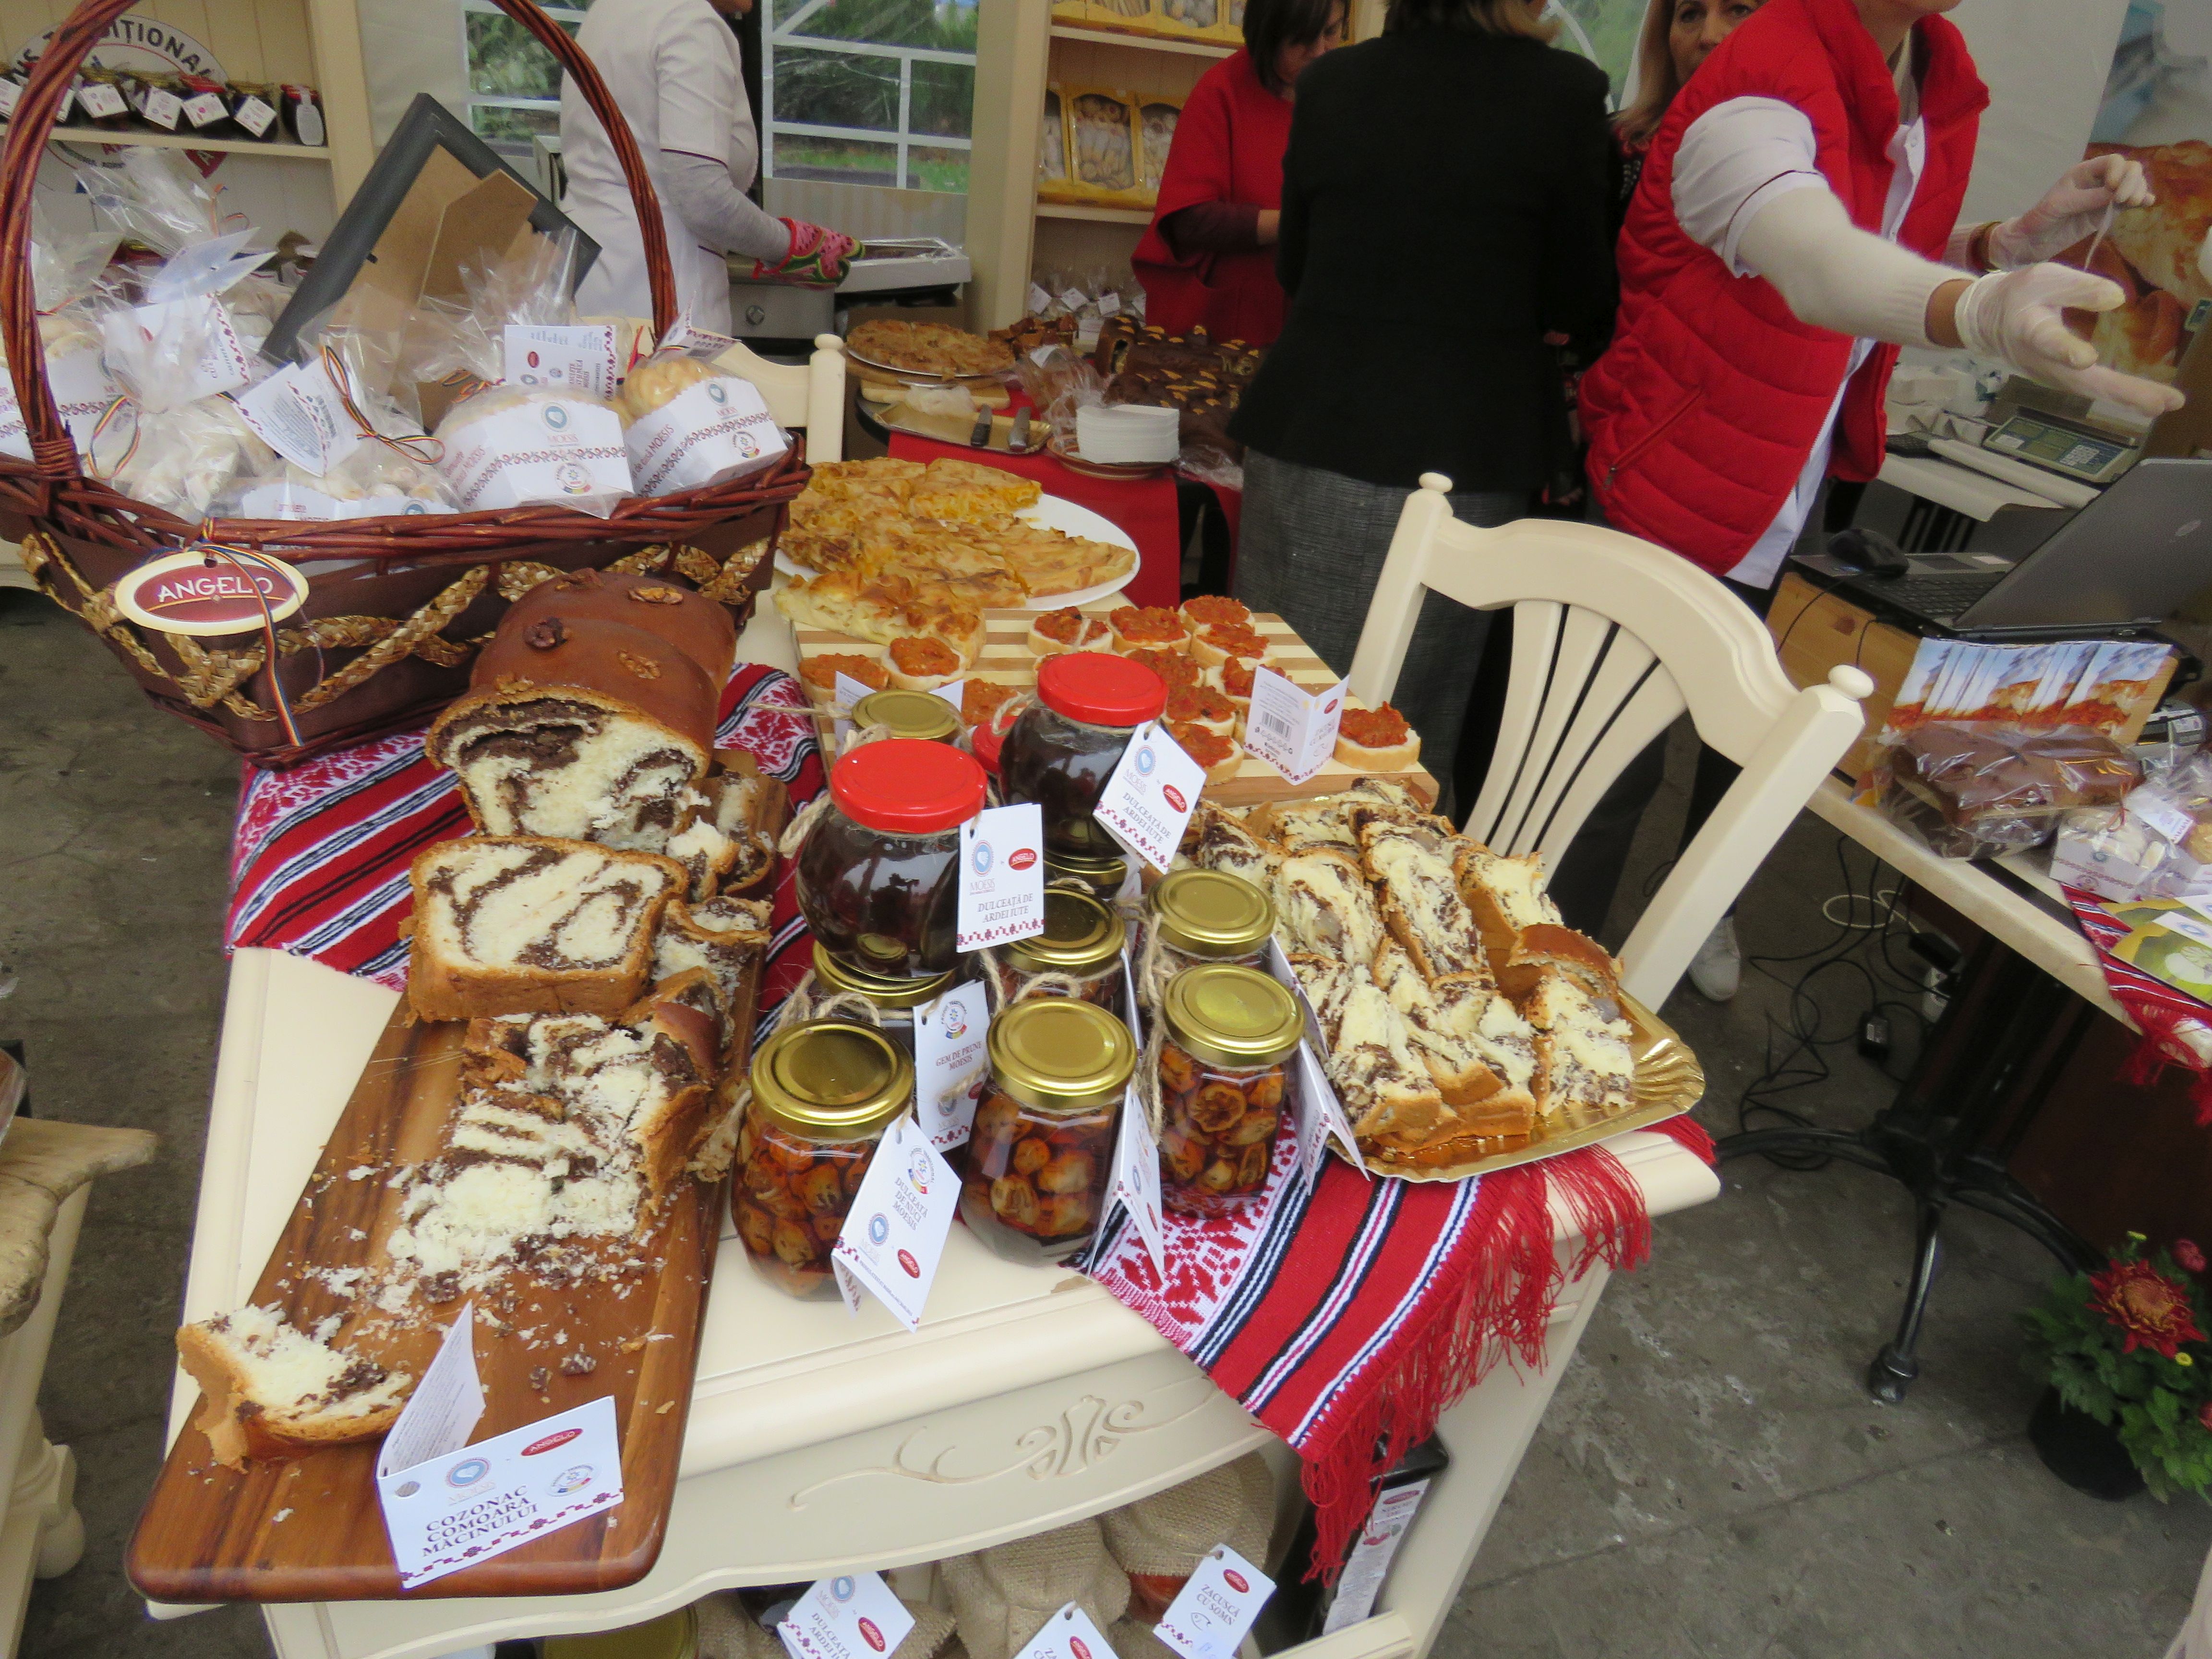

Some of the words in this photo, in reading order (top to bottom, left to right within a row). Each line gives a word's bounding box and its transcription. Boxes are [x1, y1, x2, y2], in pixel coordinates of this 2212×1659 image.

[648, 424, 674, 453] MOESIS
[157, 577, 274, 602] ANGELO
[1124, 769, 1147, 793] MOESIS
[1122, 806, 1147, 828] ARDEI
[1145, 826, 1164, 843] IUTE
[1160, 827, 1171, 839] DE
[1023, 893, 1033, 903] DE
[983, 910, 1009, 923] ARDEI
[1010, 905, 1029, 917] IUTE
[936, 1054, 951, 1066] GEM
[952, 1050, 961, 1060] DE
[893, 1201, 917, 1230] MOESIS
[895, 1190, 907, 1204] DE
[905, 1201, 922, 1223] NUCI
[530, 1431, 575, 1452] ANGELO
[427, 1485, 528, 1531] COZONAC
[427, 1497, 531, 1542] COMOARA
[1197, 1593, 1211, 1605] CU
[1209, 1603, 1236, 1625] SOMN
